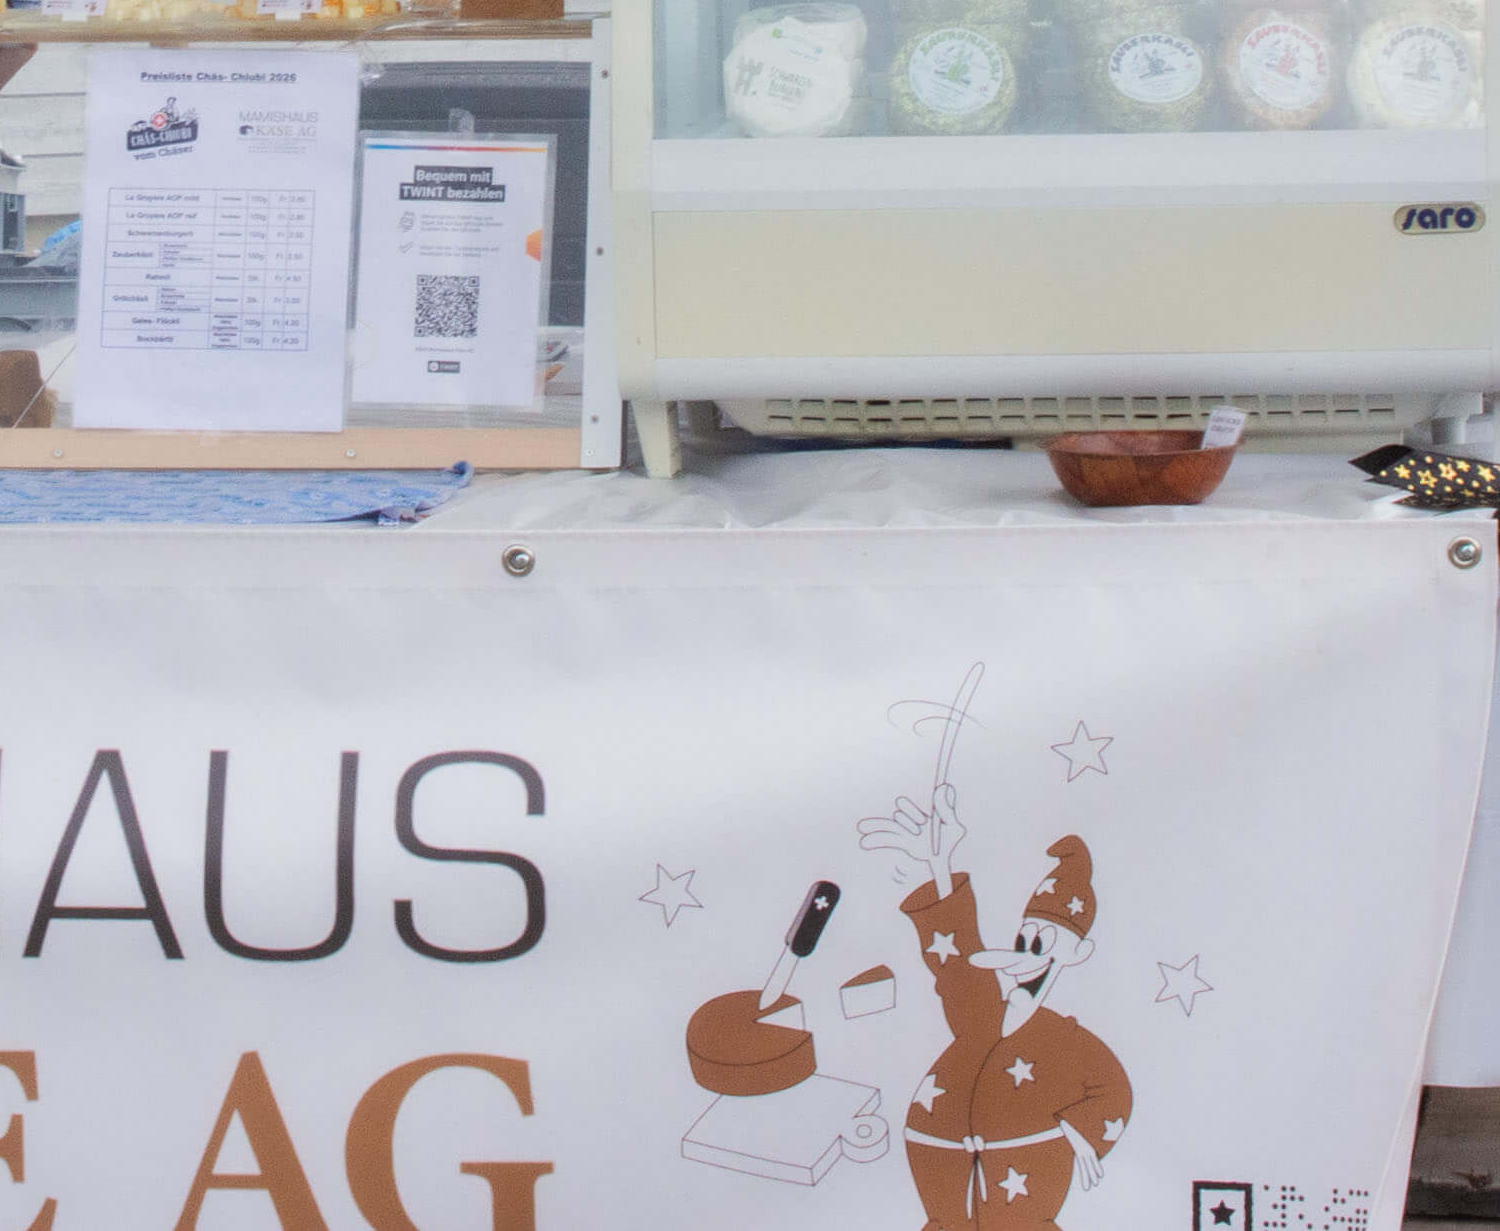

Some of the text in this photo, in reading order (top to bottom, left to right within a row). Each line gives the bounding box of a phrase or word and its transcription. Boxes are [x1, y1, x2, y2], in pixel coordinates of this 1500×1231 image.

[140, 72, 193, 82] Preisliste
[415, 170, 491, 184] Bequem mit
[402, 186, 503, 201] TWINT bezahlen
[1402, 207, 1476, 230] saro
[173, 1049, 555, 1231] AG
